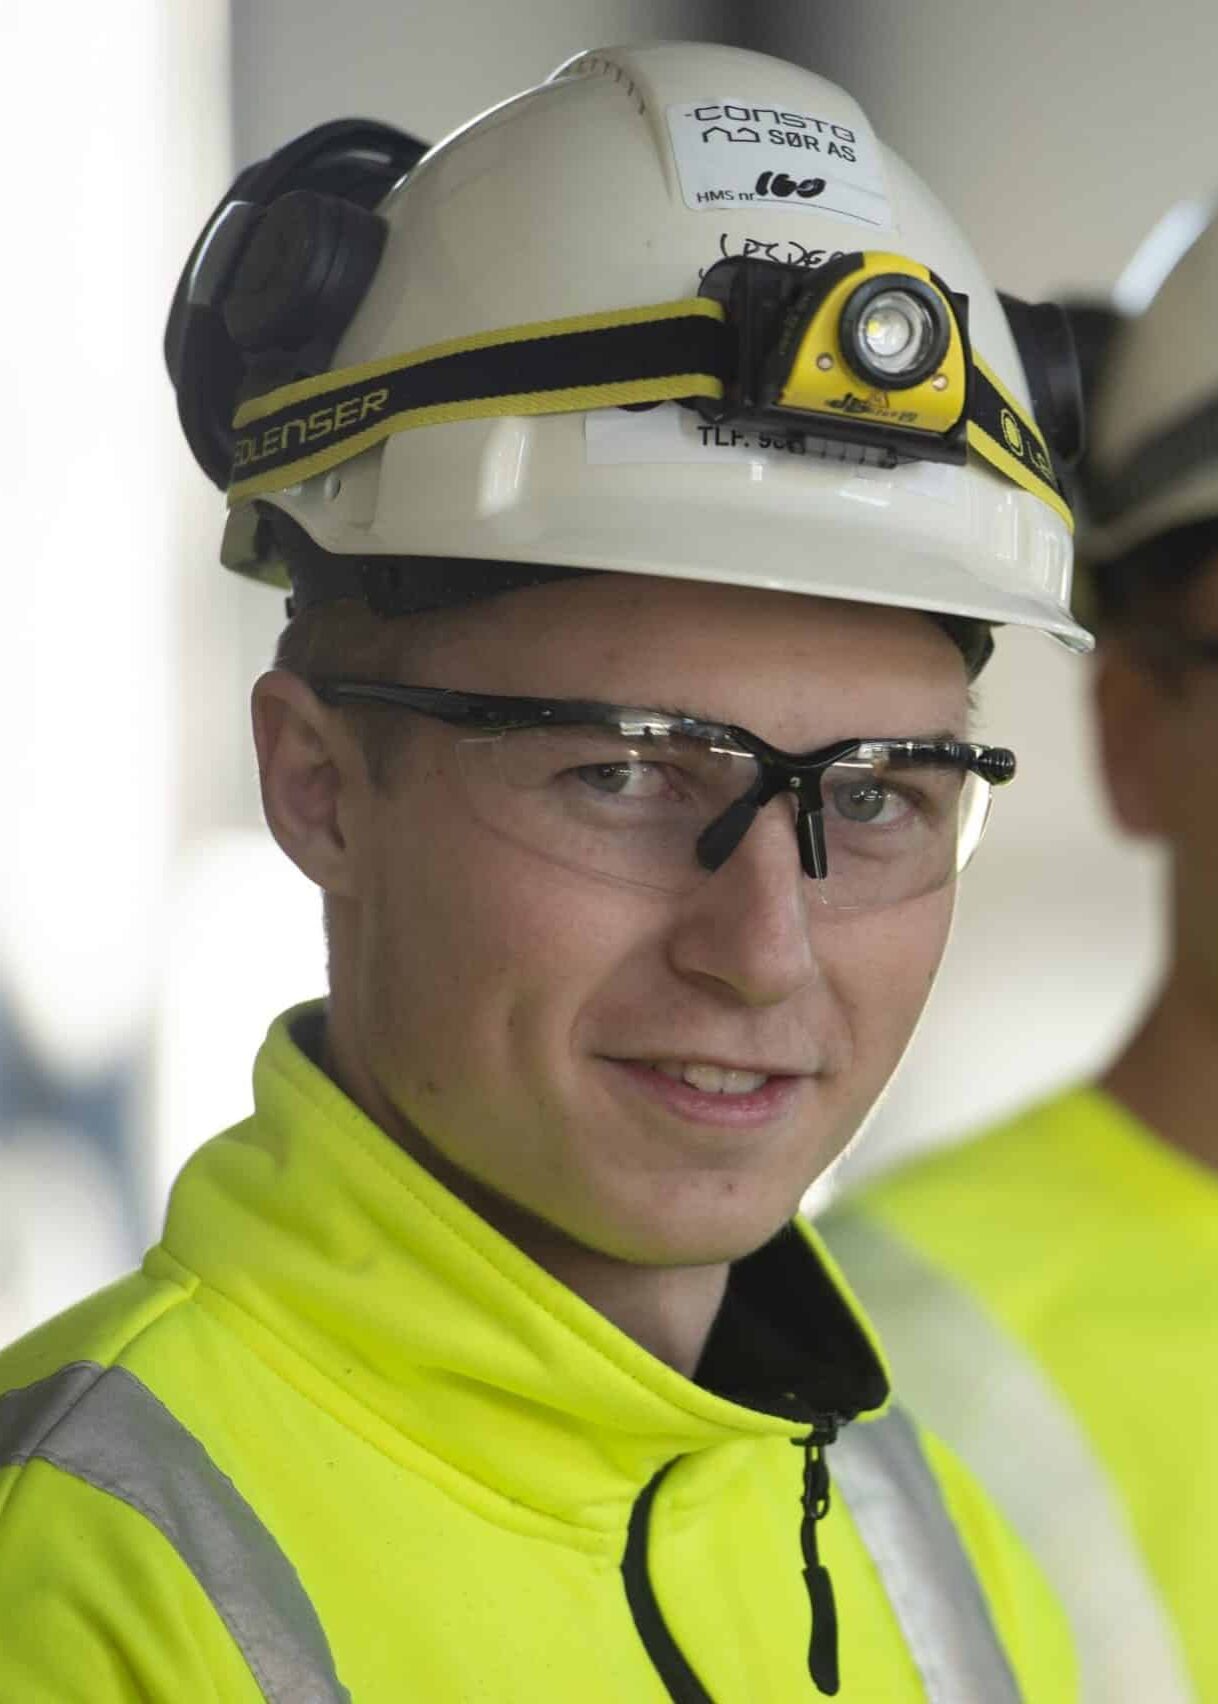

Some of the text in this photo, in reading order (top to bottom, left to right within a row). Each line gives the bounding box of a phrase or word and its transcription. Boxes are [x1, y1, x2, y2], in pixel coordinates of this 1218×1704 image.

[768, 128, 858, 163] SØR AS
[696, 190, 734, 204] HMS
[755, 171, 826, 198] 160
